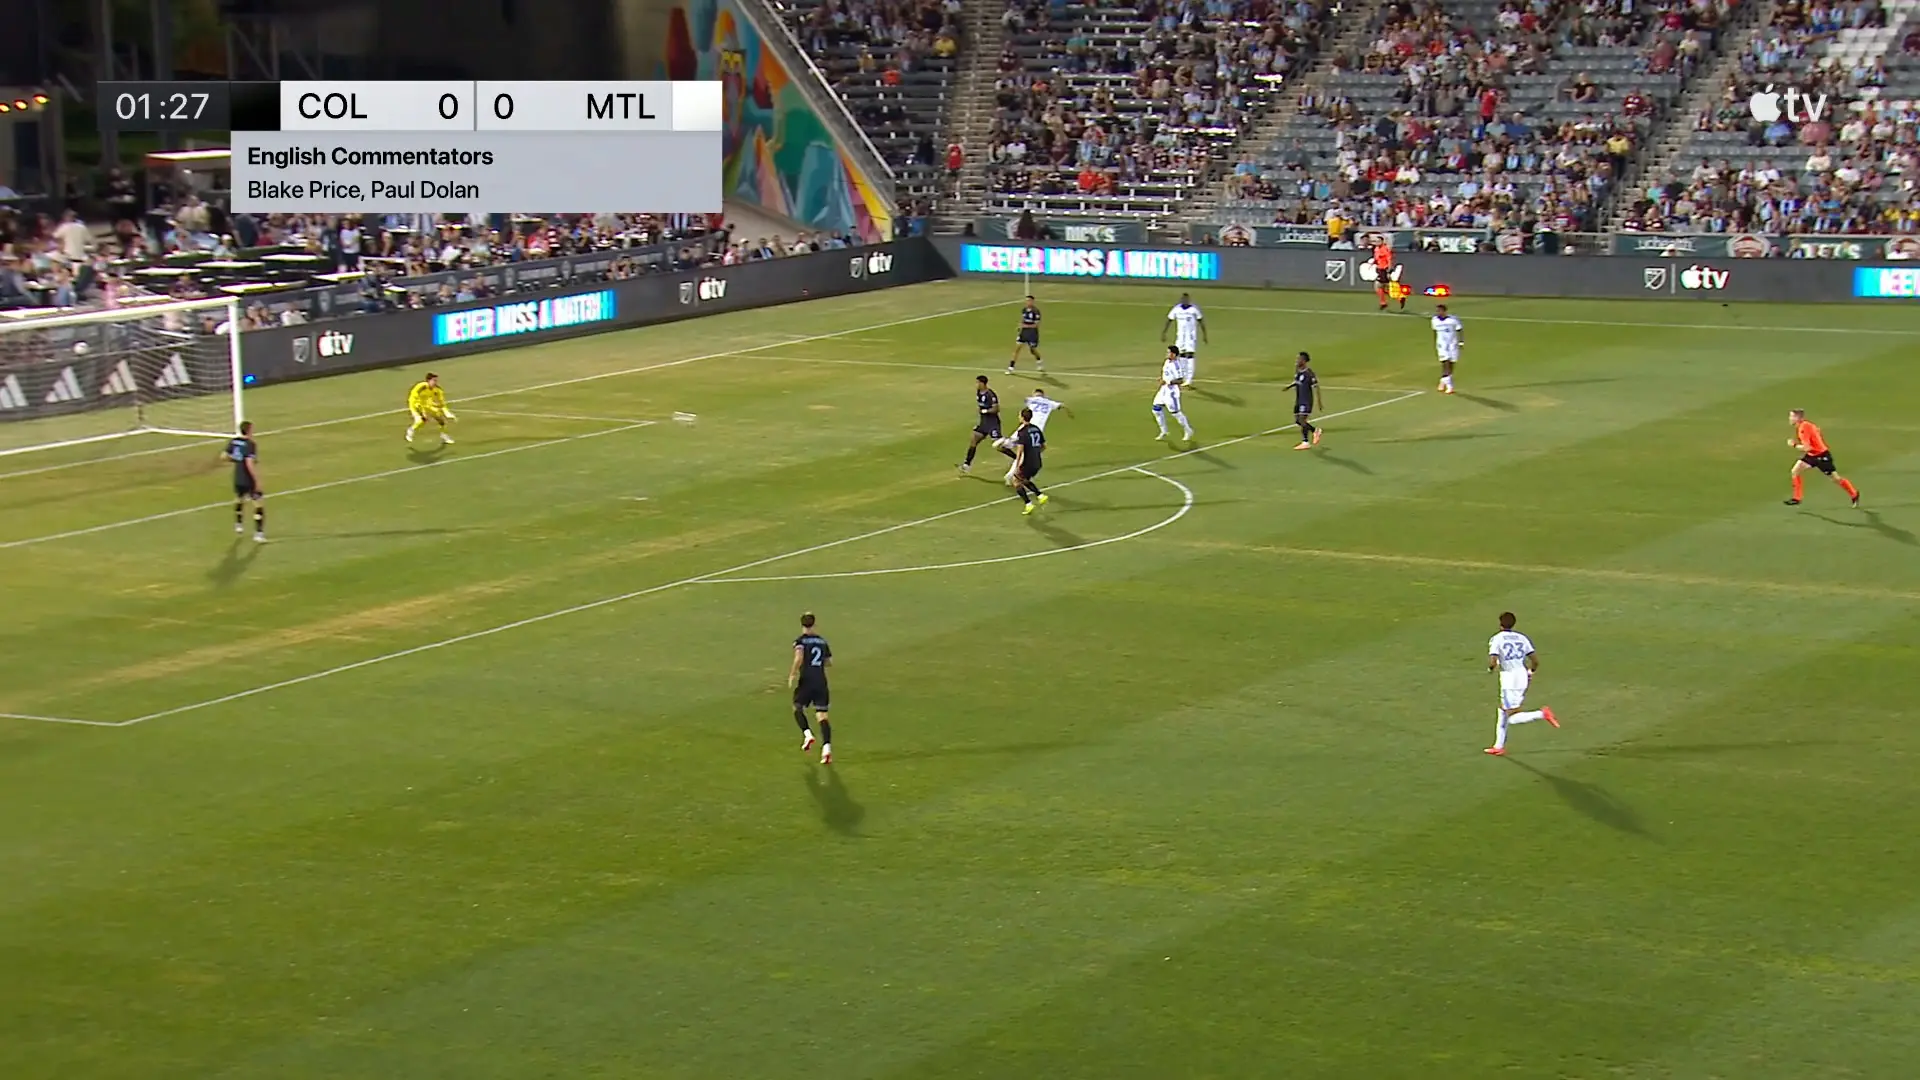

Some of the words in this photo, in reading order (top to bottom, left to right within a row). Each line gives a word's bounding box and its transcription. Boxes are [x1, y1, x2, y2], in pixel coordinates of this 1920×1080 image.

[1046, 247, 1106, 276] MISS
[1030, 432, 1041, 447] 12
[811, 646, 822, 667] 2
[1503, 642, 1525, 660] 23
